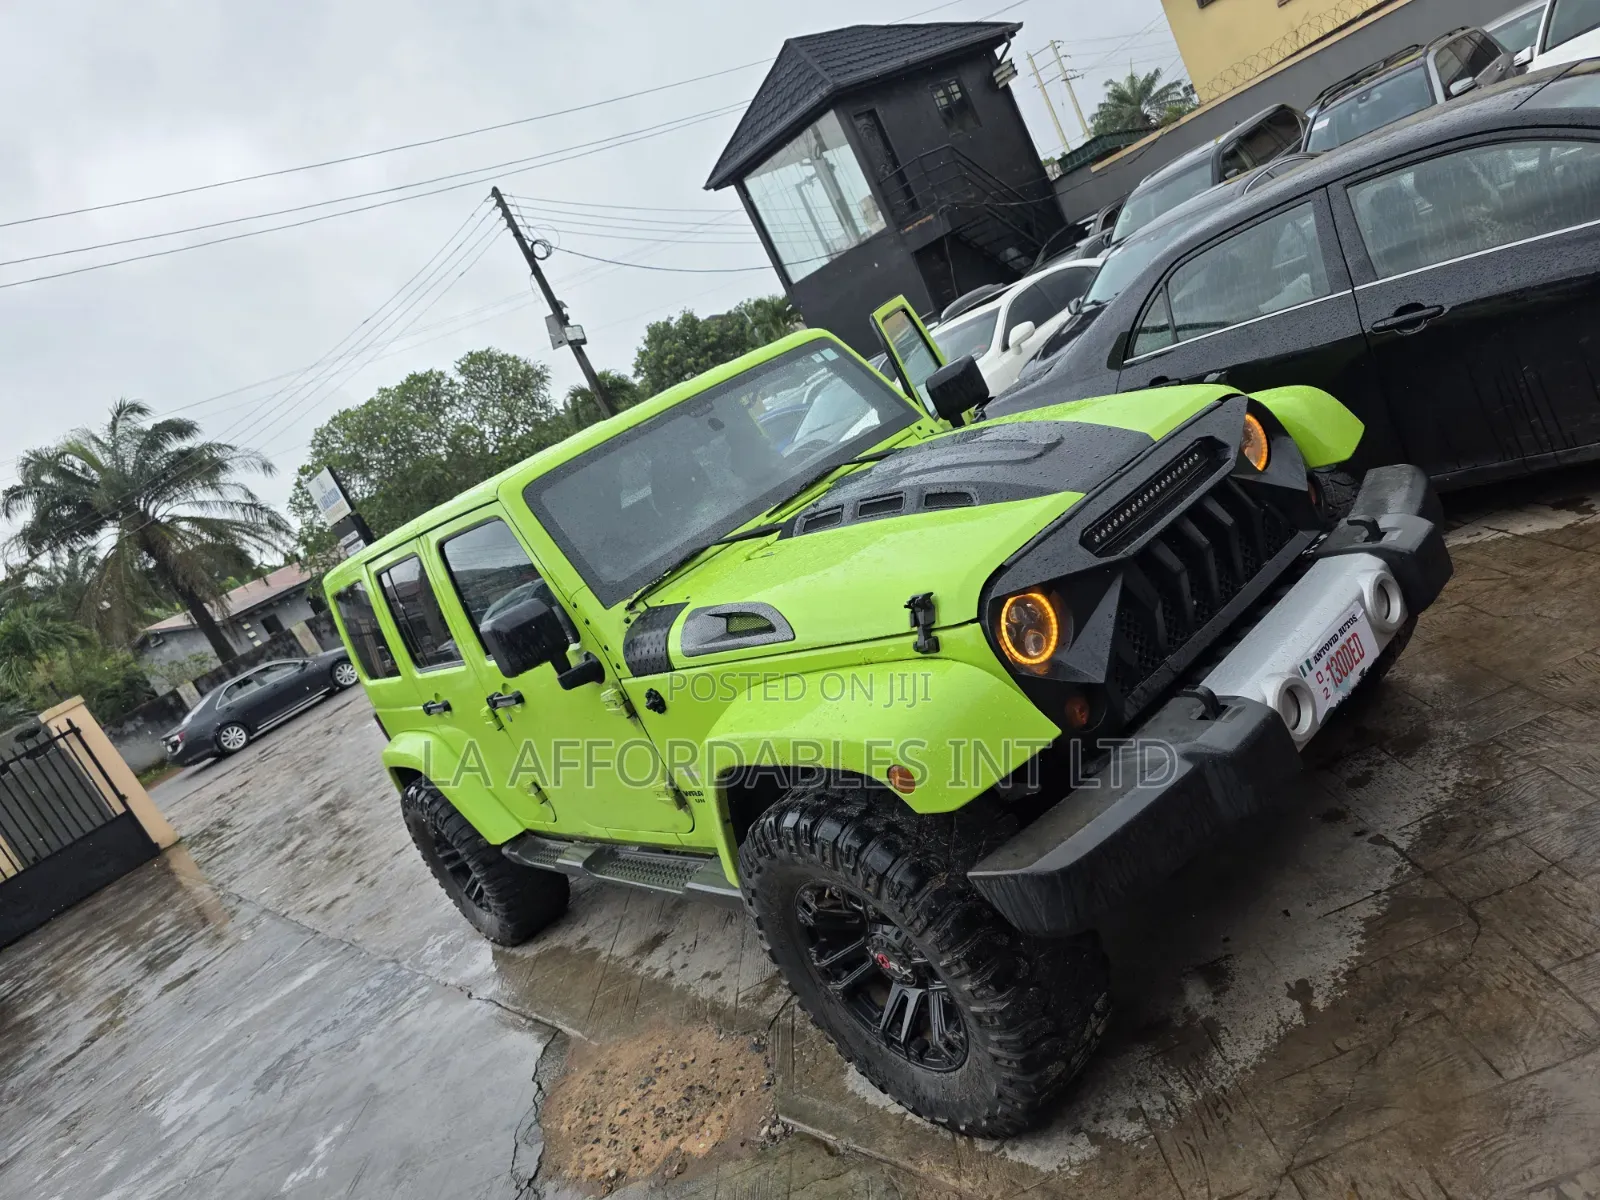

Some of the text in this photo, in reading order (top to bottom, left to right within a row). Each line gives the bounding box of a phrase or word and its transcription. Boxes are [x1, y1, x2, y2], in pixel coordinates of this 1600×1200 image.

[1313, 614, 1358, 664] ANTOVID AUTOS
[1322, 686, 1331, 700] 2
